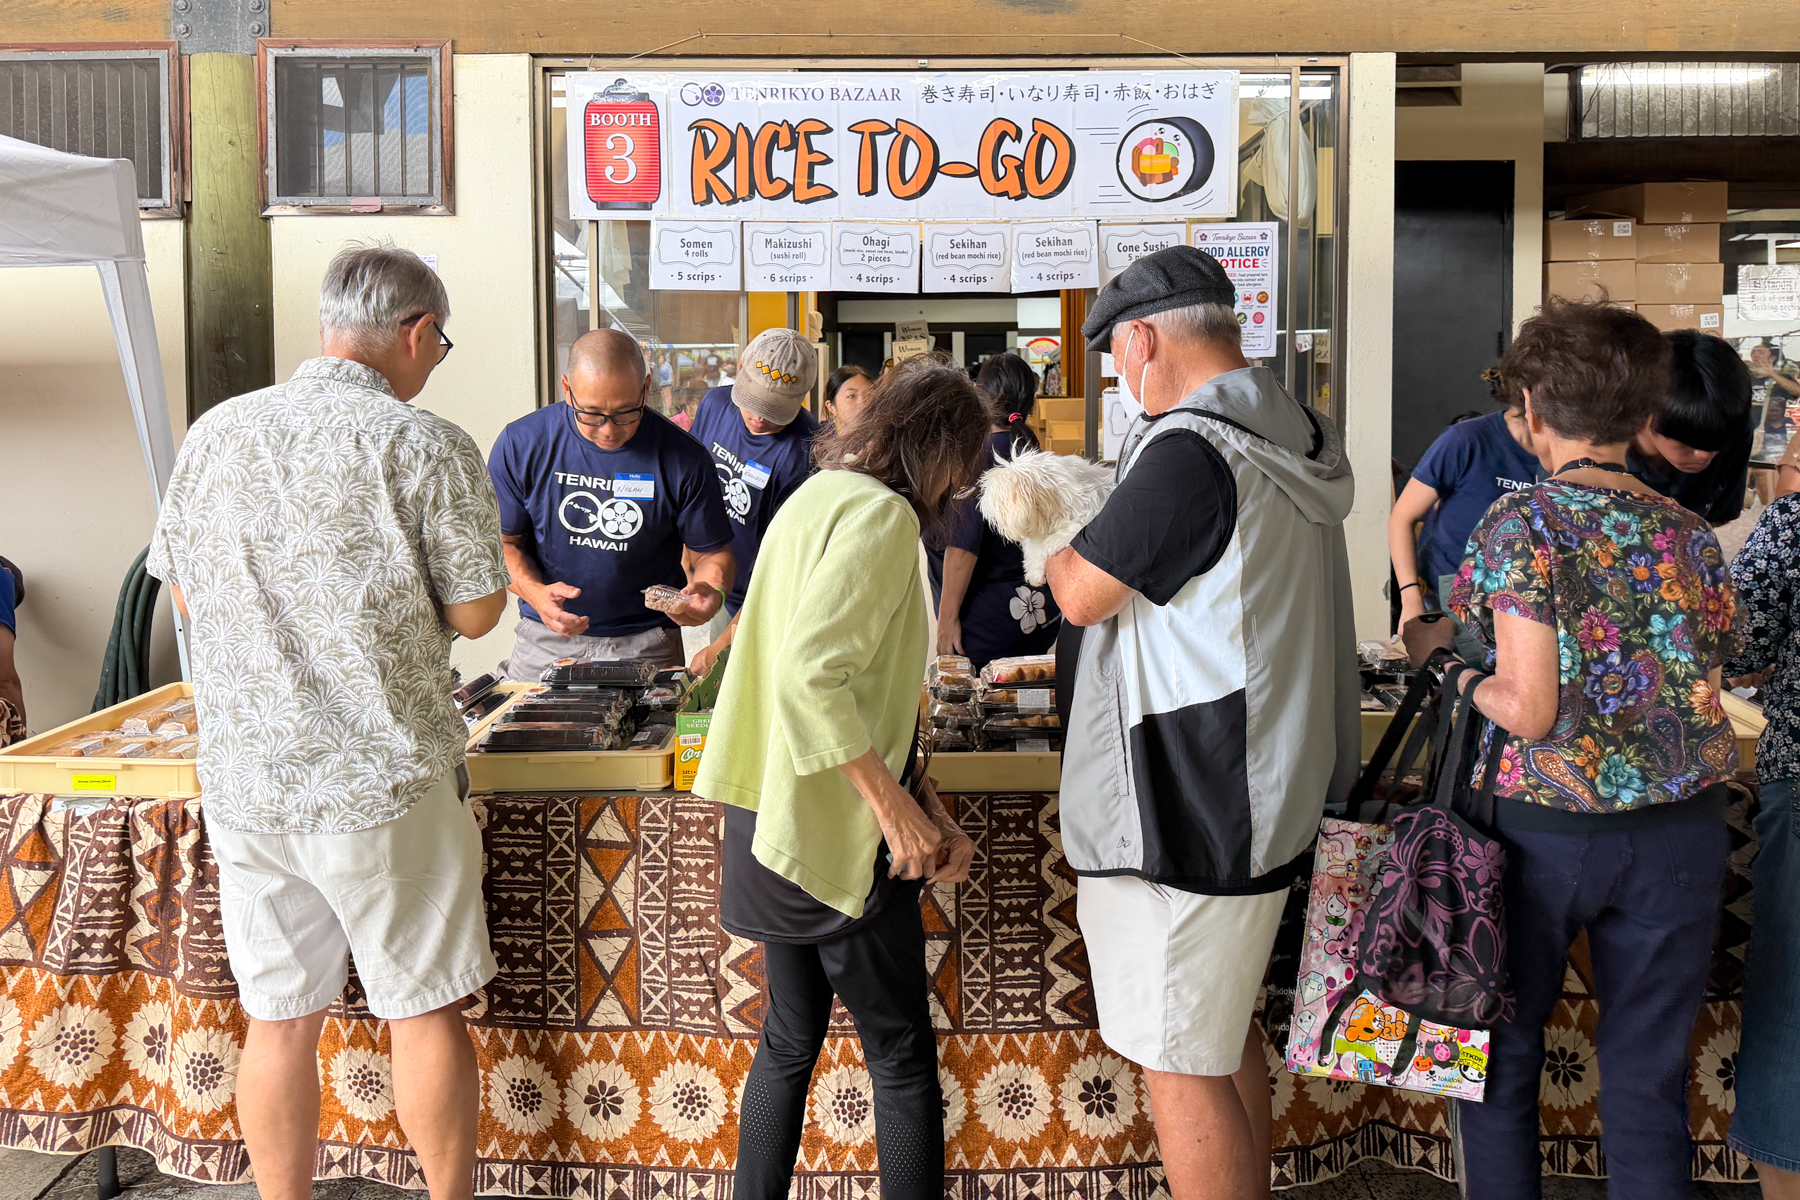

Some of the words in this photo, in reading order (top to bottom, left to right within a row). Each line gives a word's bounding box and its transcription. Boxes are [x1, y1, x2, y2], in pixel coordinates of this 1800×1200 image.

[731, 86, 825, 102] TENRIKYO
[829, 86, 902, 102] BAZAAR
[590, 113, 652, 126] BOOTH
[604, 133, 637, 184] 3
[687, 118, 839, 206] RICE
[848, 117, 1076, 202] TO-GO
[680, 238, 713, 248] Somen
[764, 238, 812, 248] Makizushi
[862, 236, 890, 250] Ohagi
[949, 239, 987, 249] Sekihan
[1035, 236, 1073, 247] Sekihan
[1117, 242, 1140, 252] Cone
[1143, 241, 1169, 251] Sushi
[770, 252, 790, 260] (sushi
[792, 252, 806, 260] roll)
[936, 252, 950, 261] (red
[987, 252, 1001, 261] rice)
[1022, 252, 1035, 261] (red
[1054, 249, 1072, 257] mochi
[1074, 248, 1088, 257] rice)
[1227, 246, 1270, 257] ALLERGY
[867, 254, 891, 263] pieces
[1216, 258, 1260, 268] OTICE
[677, 271, 684, 280] 5
[686, 272, 716, 283] scrips
[770, 274, 776, 282] 6
[779, 273, 807, 284] scrips
[856, 273, 862, 282] 4
[866, 274, 894, 285] scrips
[950, 274, 956, 283] 4
[959, 274, 988, 285] scrips
[1037, 272, 1043, 280] 4
[1046, 271, 1075, 283] scrips
[554, 472, 616, 492] TENRI
[1495, 476, 1533, 491] TENR
[616, 485, 644, 493] NOLAN
[568, 535, 629, 552] HAWAII
